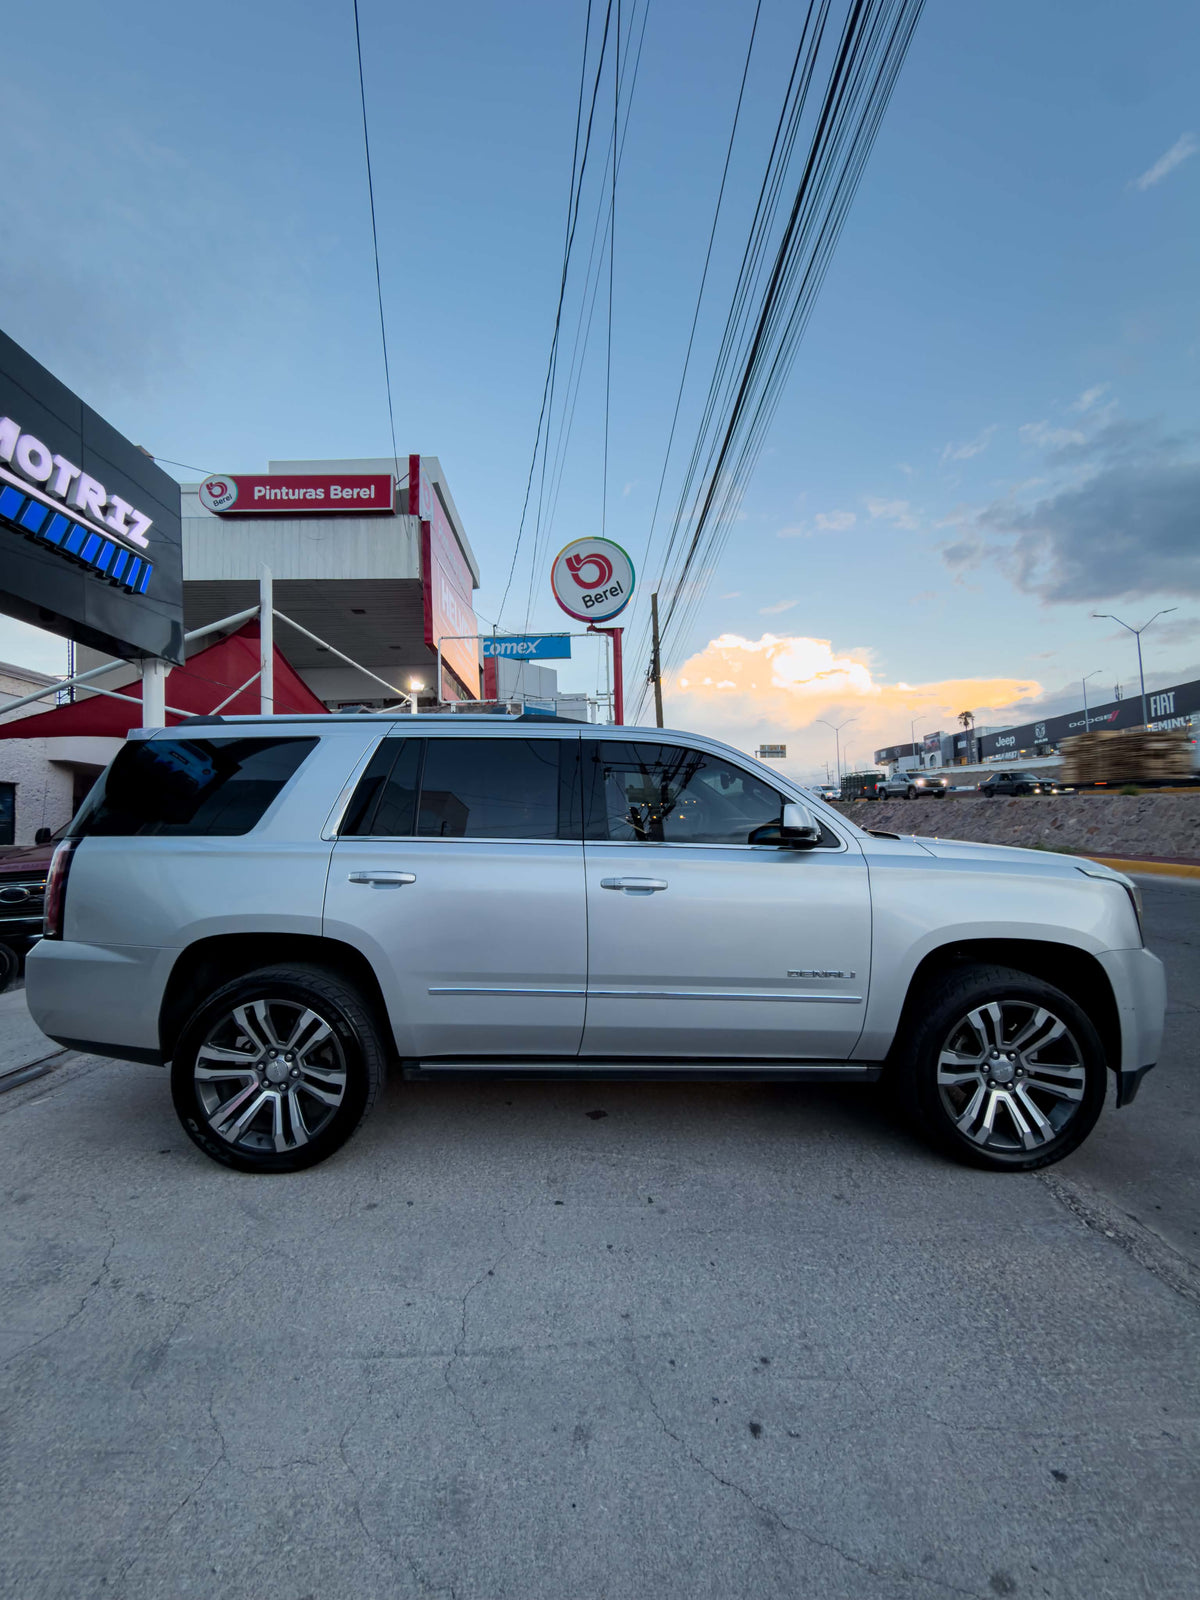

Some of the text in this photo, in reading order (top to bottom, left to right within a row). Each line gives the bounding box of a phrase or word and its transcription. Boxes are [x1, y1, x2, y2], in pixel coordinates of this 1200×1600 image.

[213, 493, 233, 507] Berel
[253, 485, 375, 500] Pinturas Berel
[581, 580, 624, 609] Berel
[1150, 691, 1176, 718] FIAT
[1069, 713, 1113, 728] DODGE
[995, 735, 1016, 748] Jeep
[787, 969, 857, 979] DENALI
